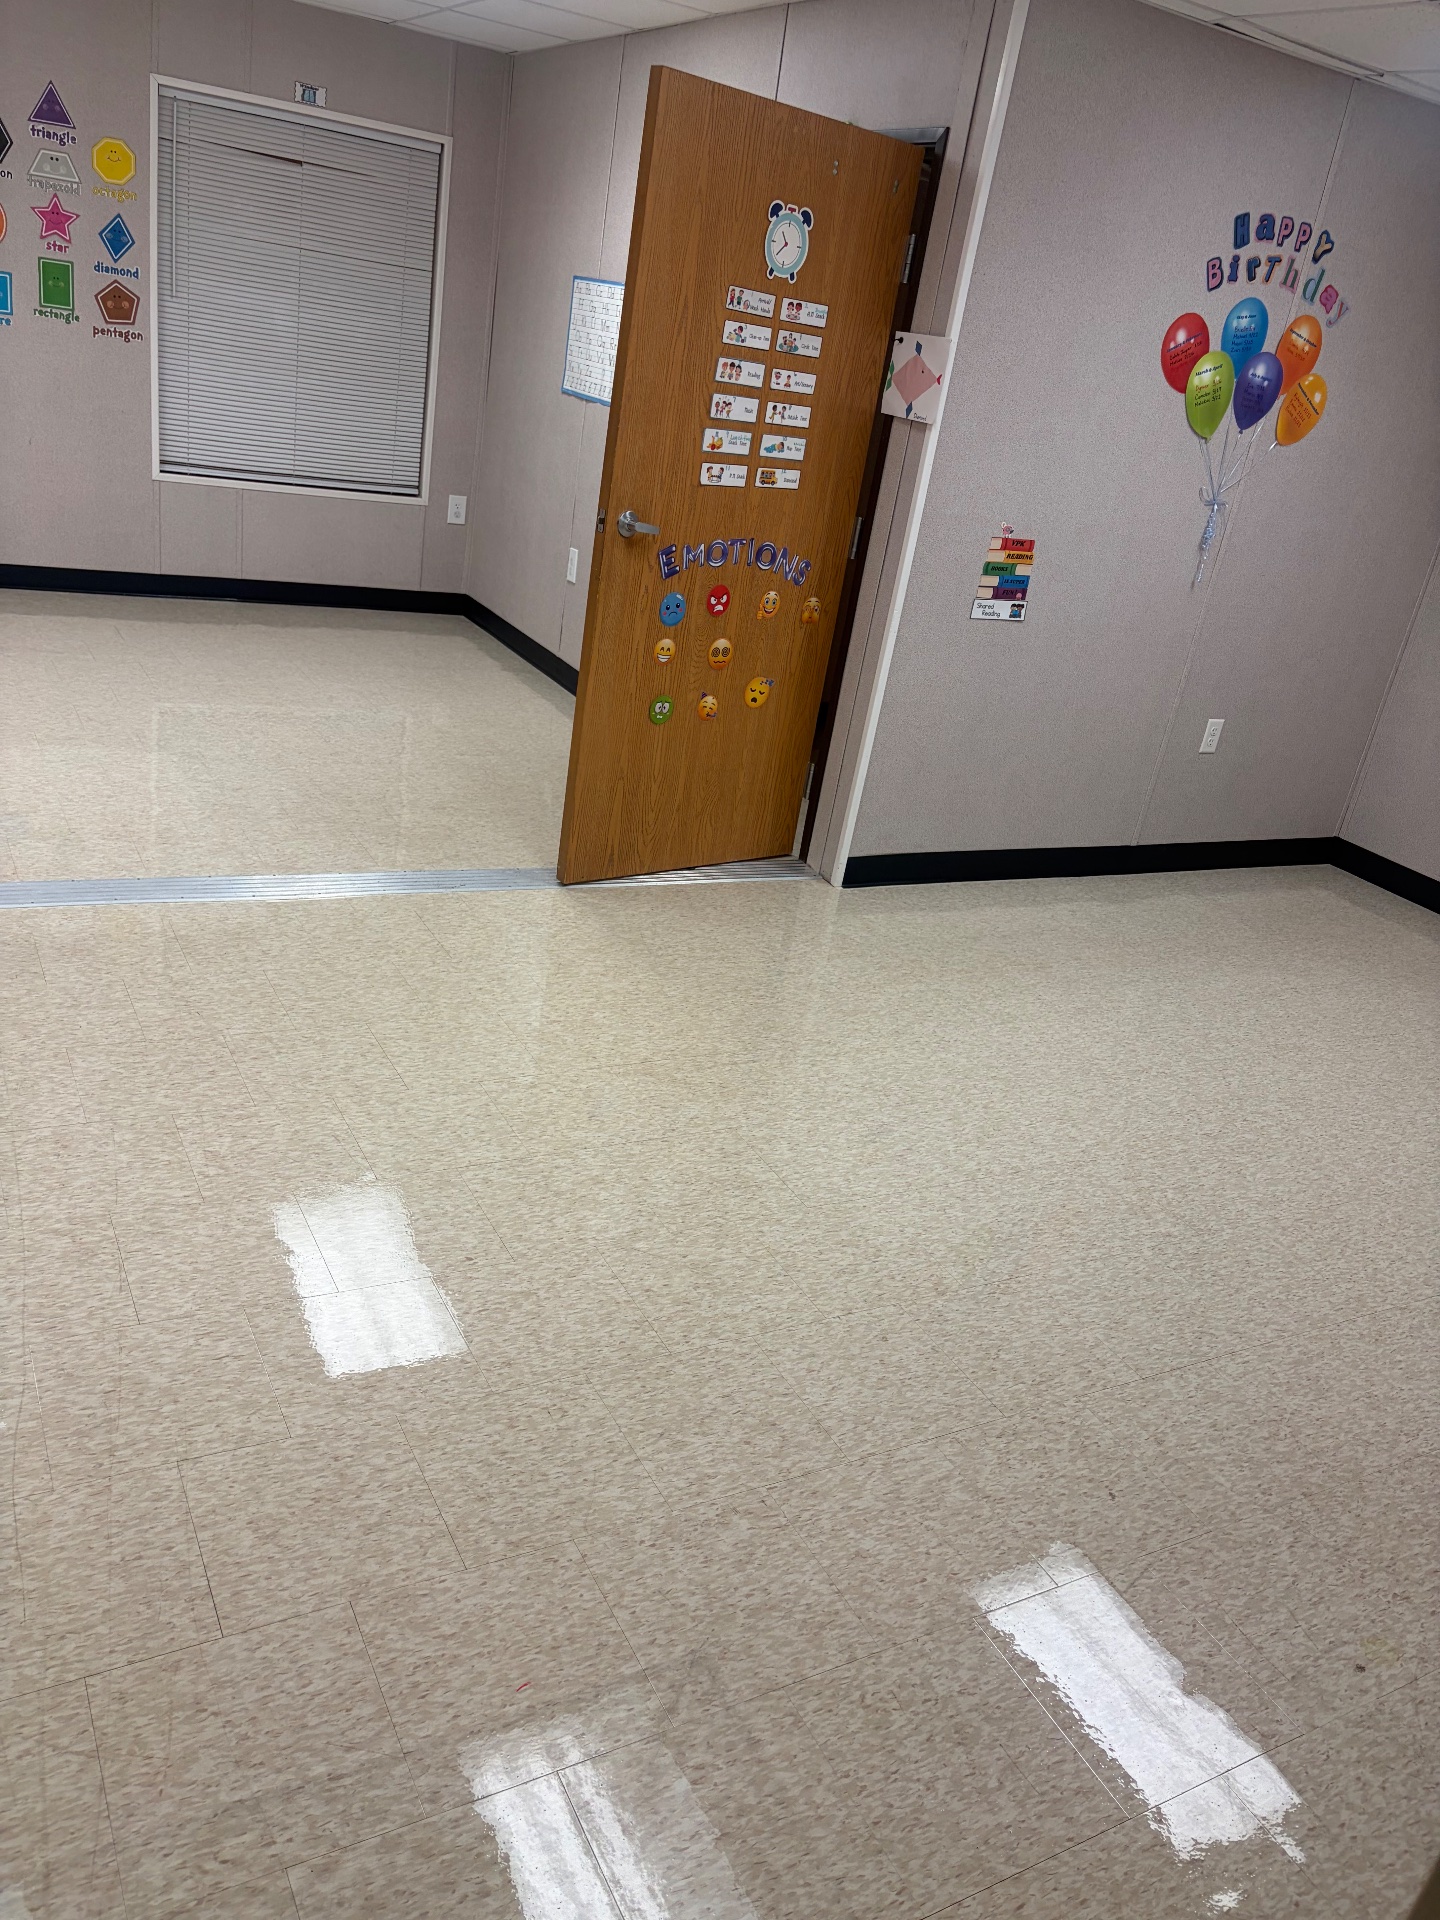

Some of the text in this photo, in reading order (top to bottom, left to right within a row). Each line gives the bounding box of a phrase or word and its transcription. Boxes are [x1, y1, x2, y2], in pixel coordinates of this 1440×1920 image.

[30, 125, 77, 147] triangle
[27, 175, 81, 195] trapezoid
[92, 186, 138, 203] octagon
[46, 240, 70, 253] star
[94, 261, 139, 280] diamond
[33, 308, 80, 325] rectangle
[92, 326, 143, 343] pentagon
[658, 538, 812, 586] EMOTIONS
[976, 602, 995, 610] Shared
[981, 610, 1001, 618] Reading
